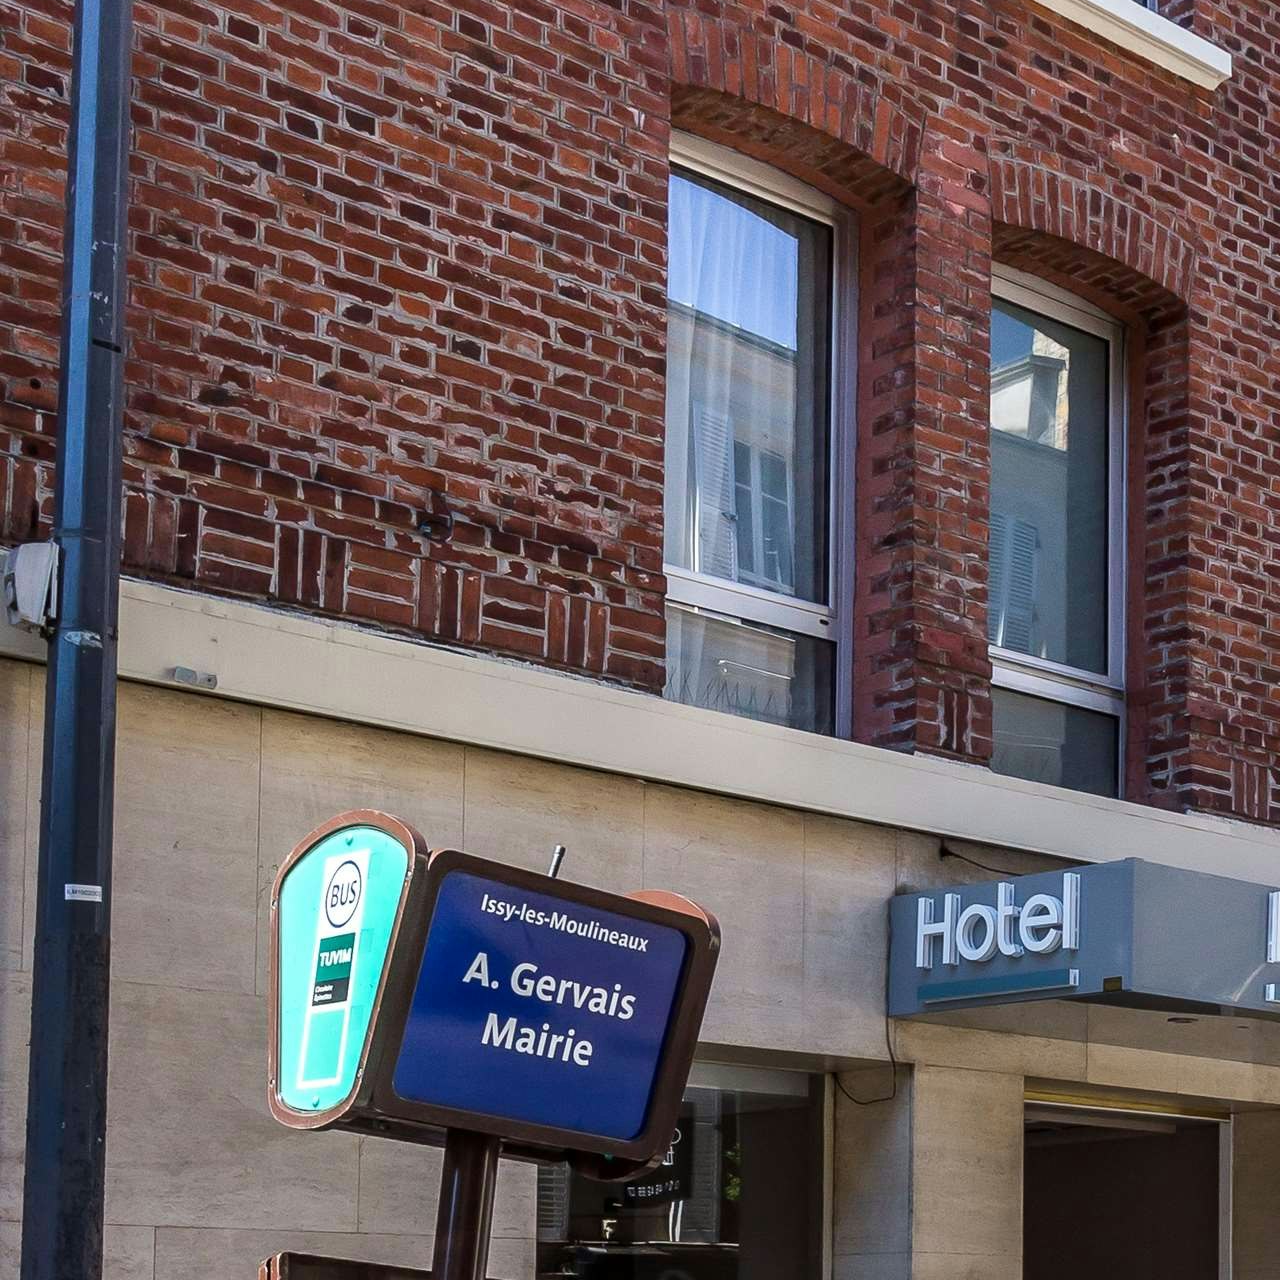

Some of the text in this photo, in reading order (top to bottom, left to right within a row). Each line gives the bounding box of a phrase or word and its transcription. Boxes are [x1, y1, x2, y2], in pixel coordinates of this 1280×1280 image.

[330, 880, 357, 908] BUS
[914, 872, 1081, 971] Hotel
[481, 893, 649, 952] Issy-les-Moulineaux
[320, 947, 352, 967] TUVIM
[462, 952, 637, 1020] A. Gervais
[481, 1012, 593, 1066] Mairie
